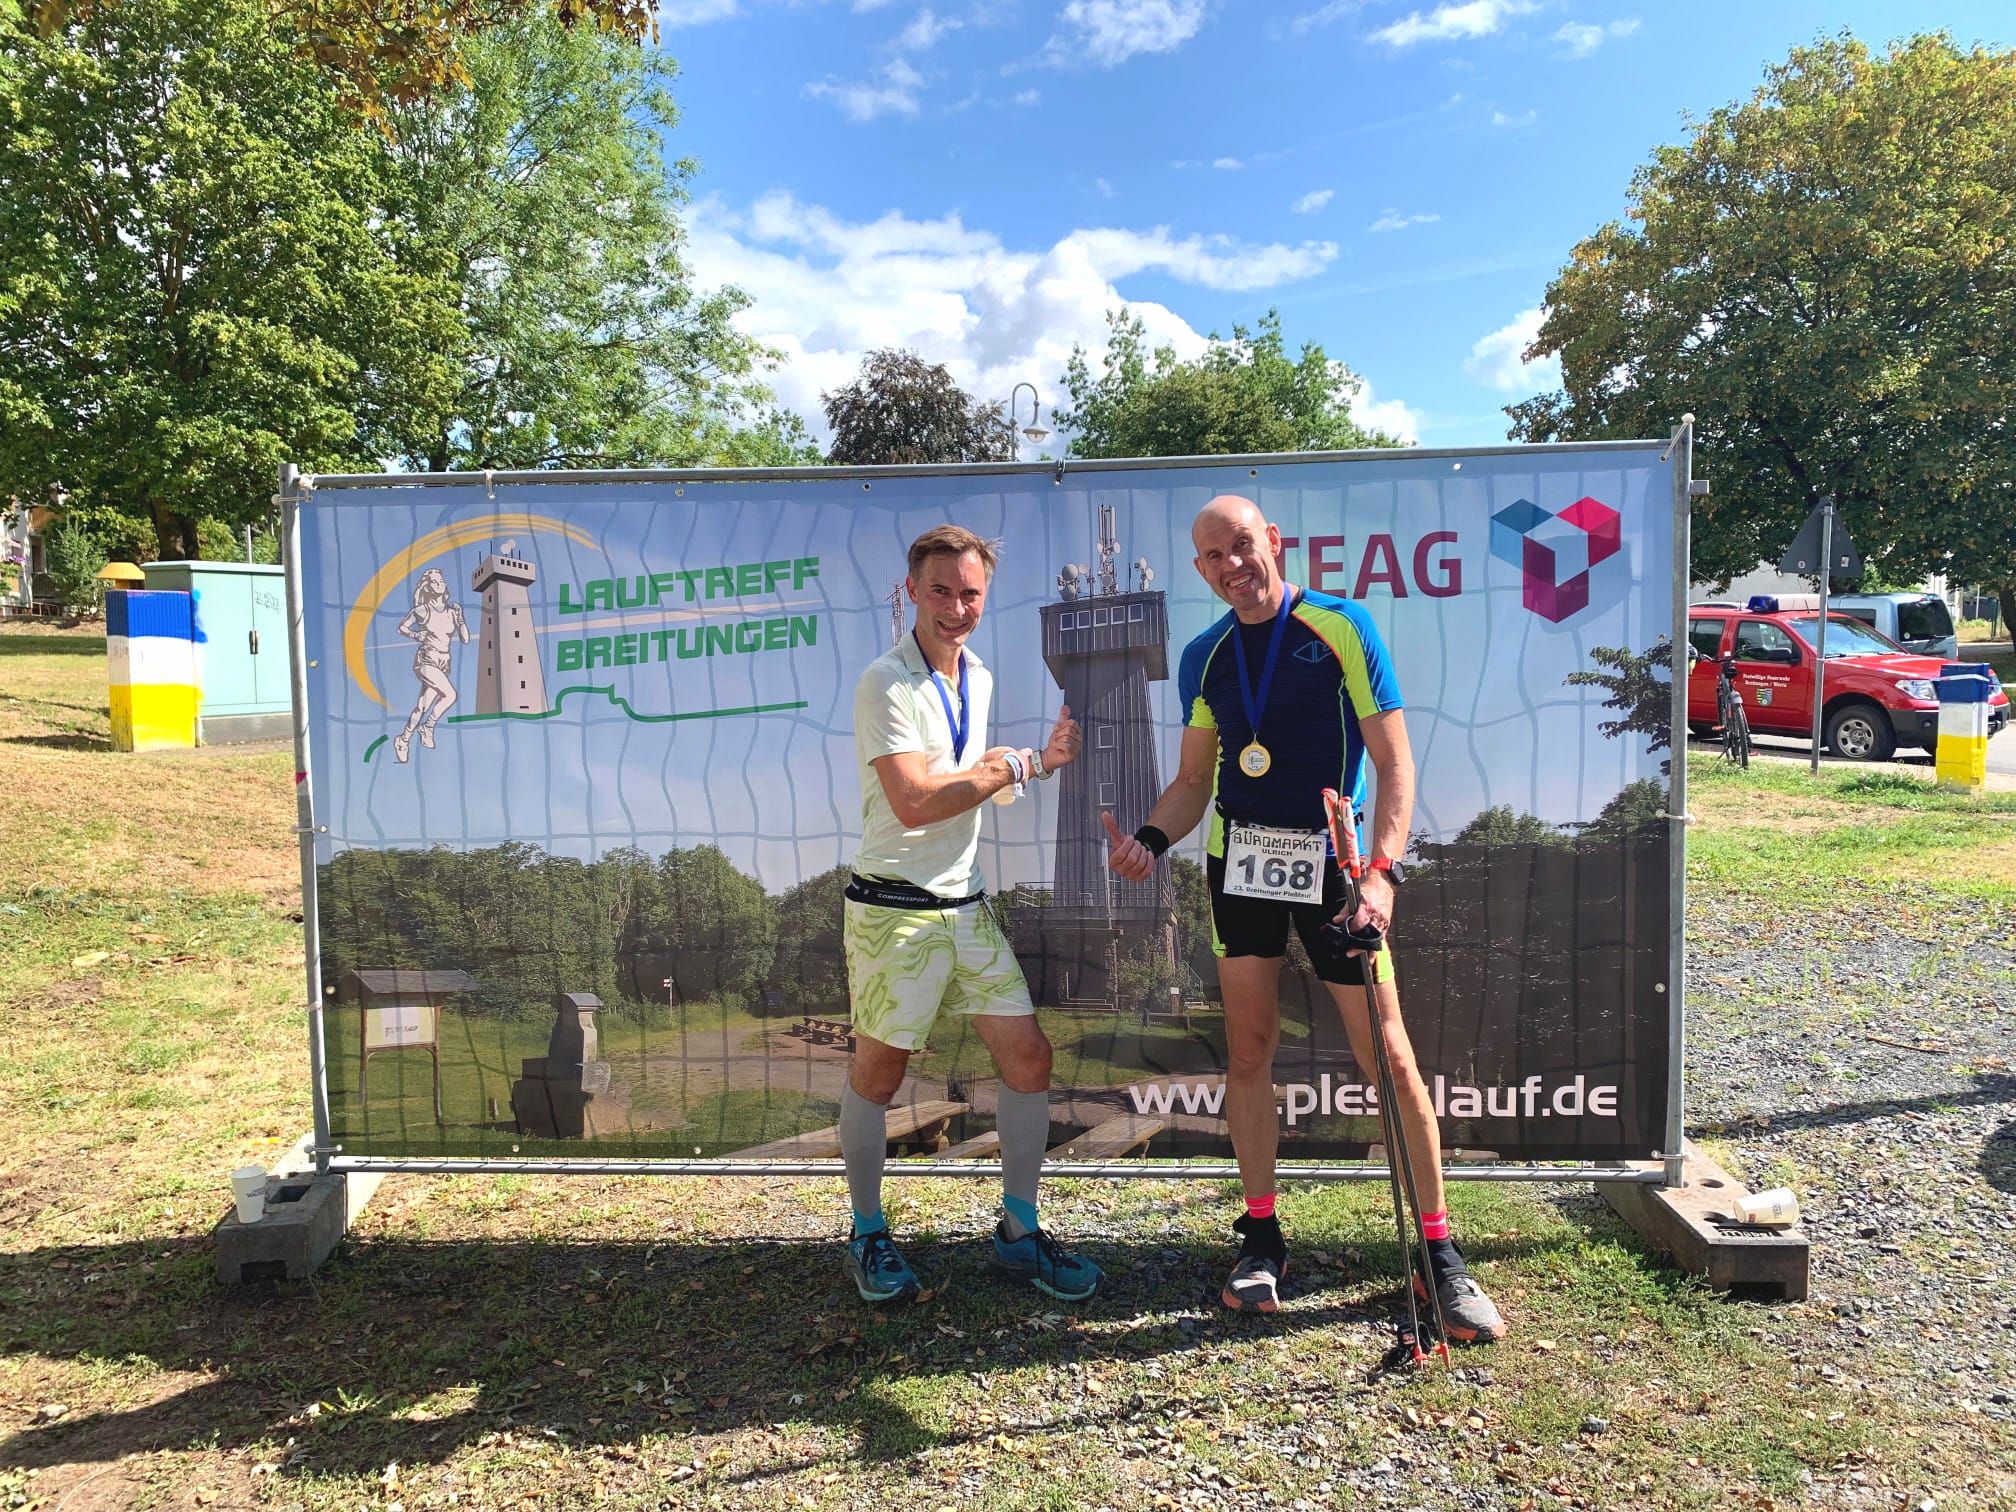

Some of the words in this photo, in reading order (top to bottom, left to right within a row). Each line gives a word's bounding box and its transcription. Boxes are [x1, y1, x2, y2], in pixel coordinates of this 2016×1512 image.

[1278, 531, 1463, 601] TEAG
[559, 556, 820, 615] LAUFTREFF
[556, 615, 818, 672] BREITUNGEN
[1234, 831, 1322, 852] BÜROMARKT
[1262, 848, 1292, 856] ULRICH
[1238, 855, 1313, 890] 168
[877, 893, 929, 903] COMPRESSPORT
[1246, 887, 1281, 896] Breitunger
